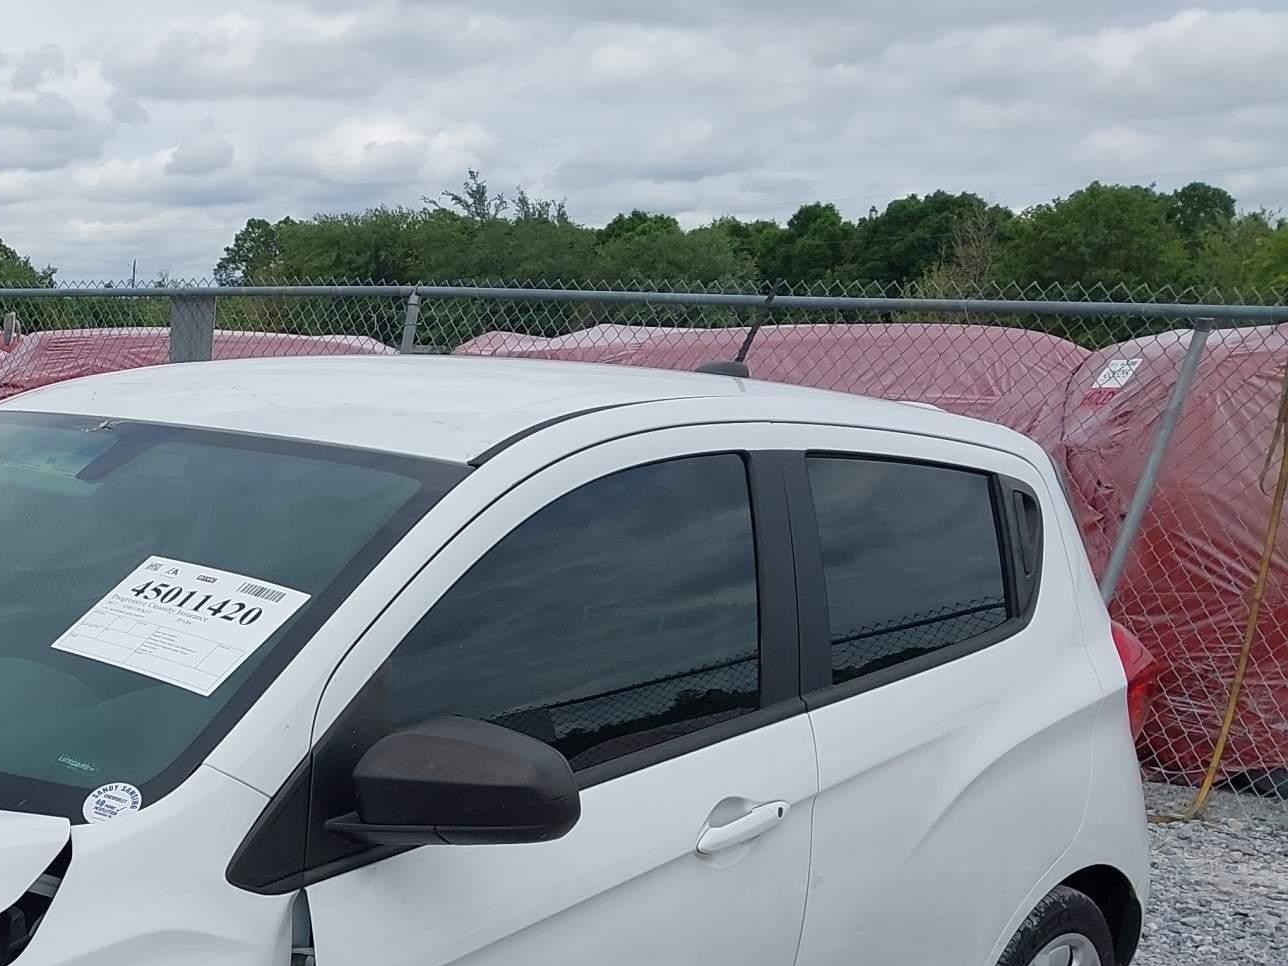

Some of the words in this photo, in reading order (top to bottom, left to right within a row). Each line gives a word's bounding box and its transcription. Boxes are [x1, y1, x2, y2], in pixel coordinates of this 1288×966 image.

[111, 593, 148, 608] Progressive
[176, 608, 209, 624] Insurance
[130, 579, 264, 627] 45011420
[92, 784, 119, 799] SANDY
[121, 785, 140, 810] SANSING
